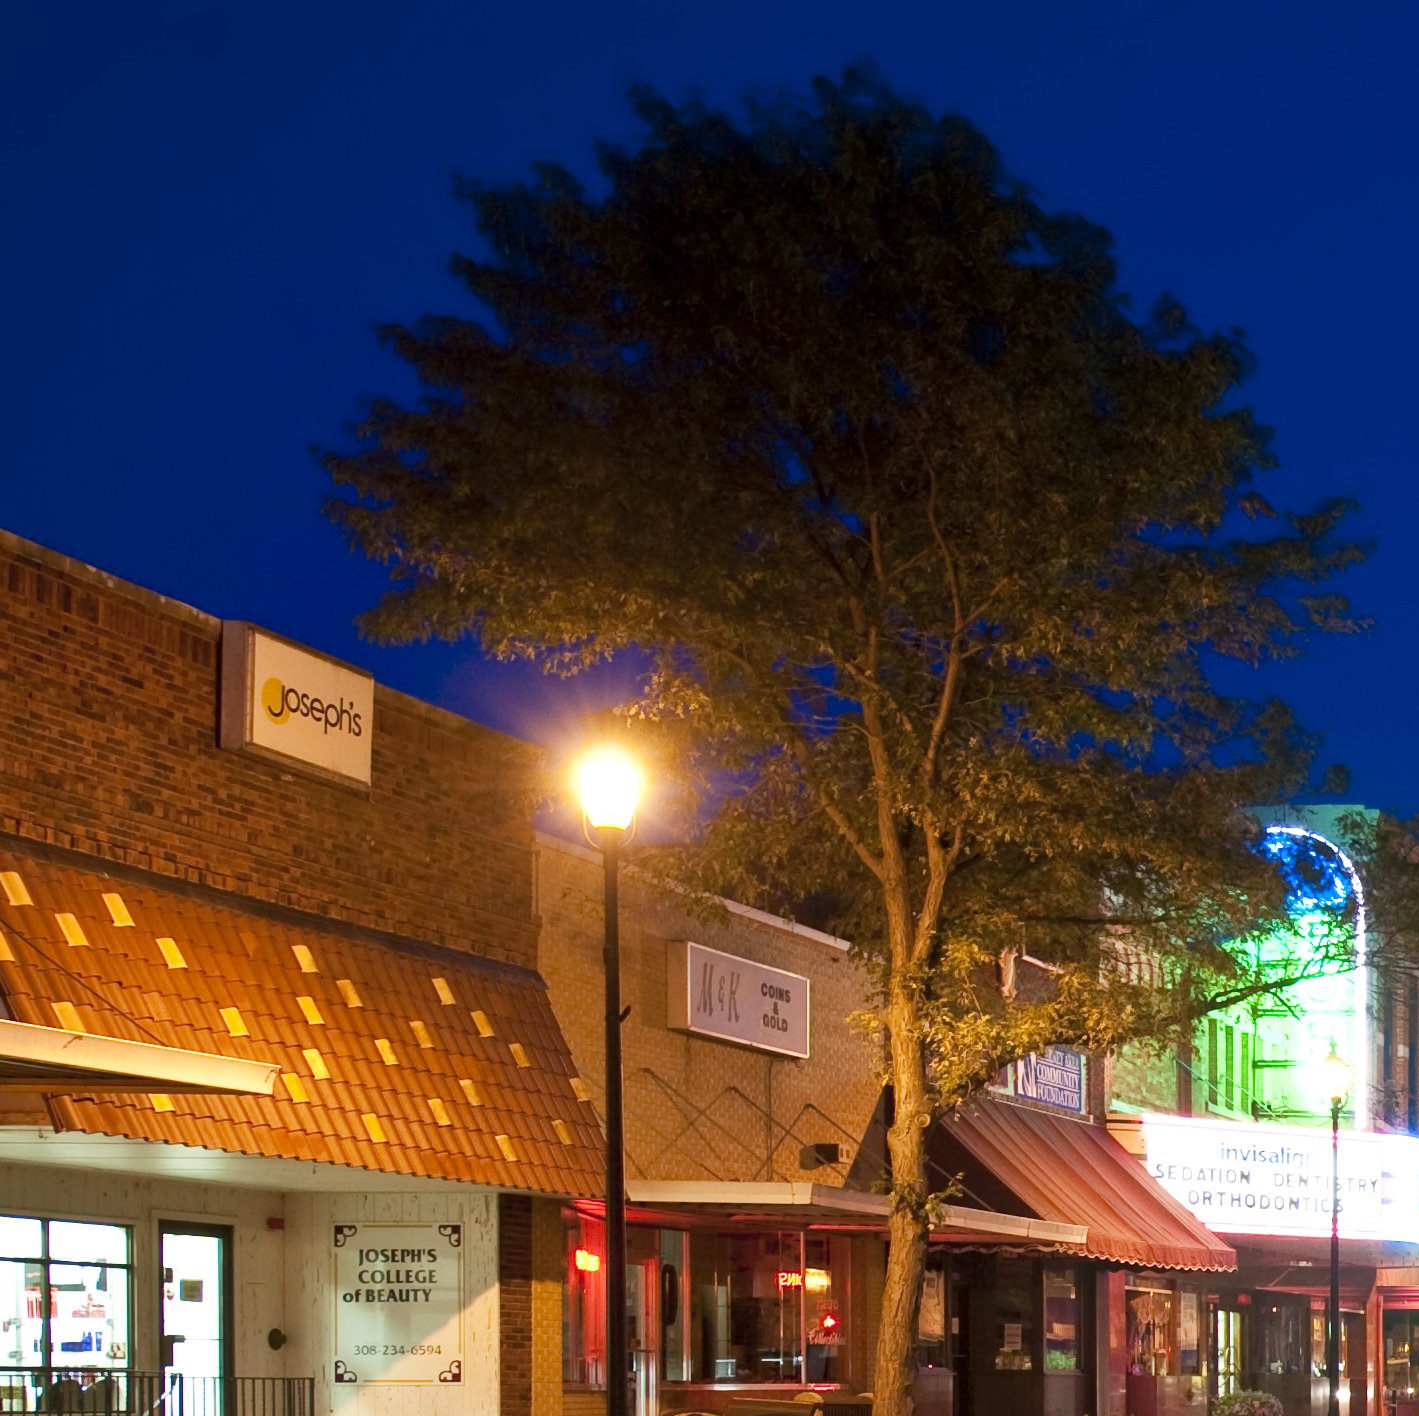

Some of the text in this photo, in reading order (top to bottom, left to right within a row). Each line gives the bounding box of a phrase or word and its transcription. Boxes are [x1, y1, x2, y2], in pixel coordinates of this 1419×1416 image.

[697, 962, 740, 1023] M & K
[760, 982, 791, 1003] COINS
[772, 1001, 779, 1015] &
[762, 1014, 788, 1032] GOLD
[1037, 1063, 1079, 1089] COMMUNITY
[1037, 1083, 1079, 1108] FOUNDATION
[1155, 1164, 1378, 1193] SEDATION DENTISTRY
[1189, 1190, 1344, 1213] ORTHODONTICS
[358, 1249, 437, 1266] JOSEPH'S
[358, 1270, 437, 1284] COLLEGE
[343, 1289, 432, 1302] of BEAUTY
[354, 1345, 442, 1357] 308-234-6594
